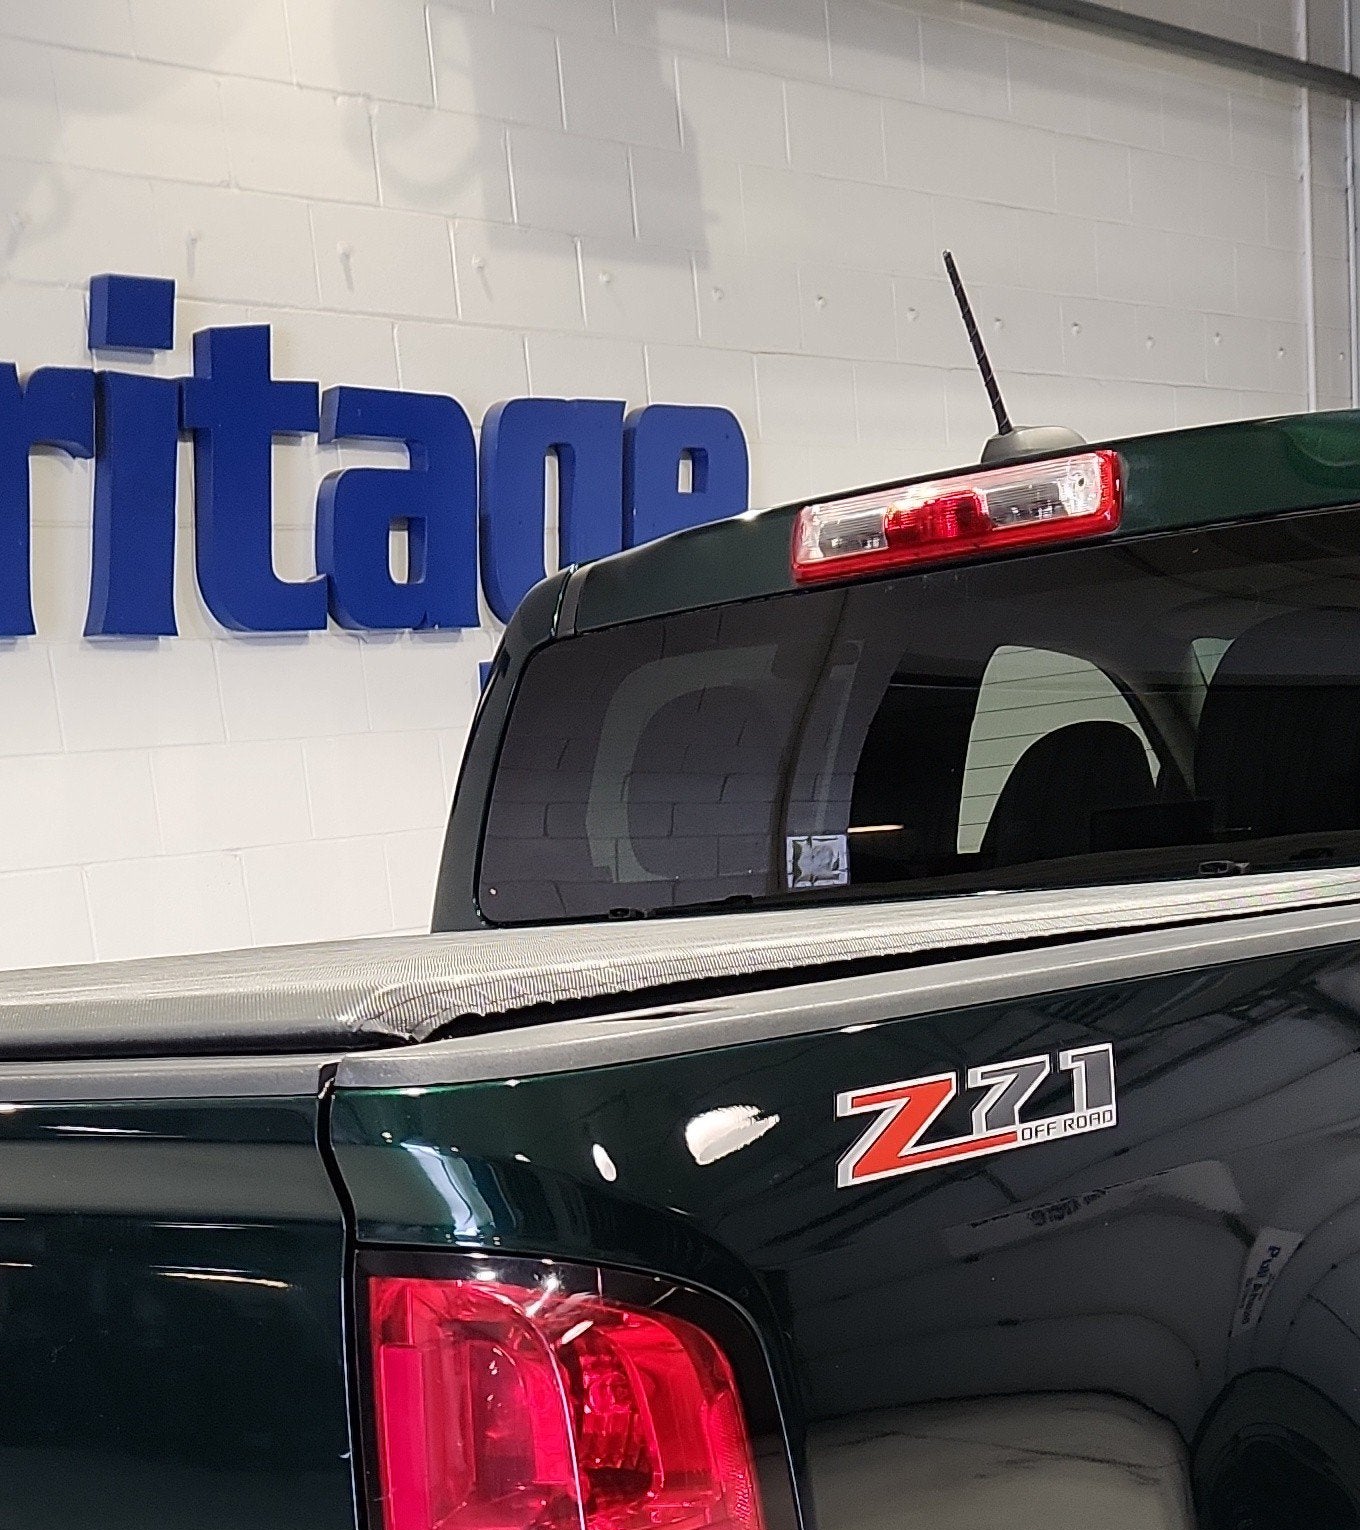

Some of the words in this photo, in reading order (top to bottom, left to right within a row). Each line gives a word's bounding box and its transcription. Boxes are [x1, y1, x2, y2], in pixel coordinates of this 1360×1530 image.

[834, 1043, 1117, 1188] Z71
[1021, 1121, 1058, 1142] OFF
[1063, 1109, 1114, 1134] ROAD
